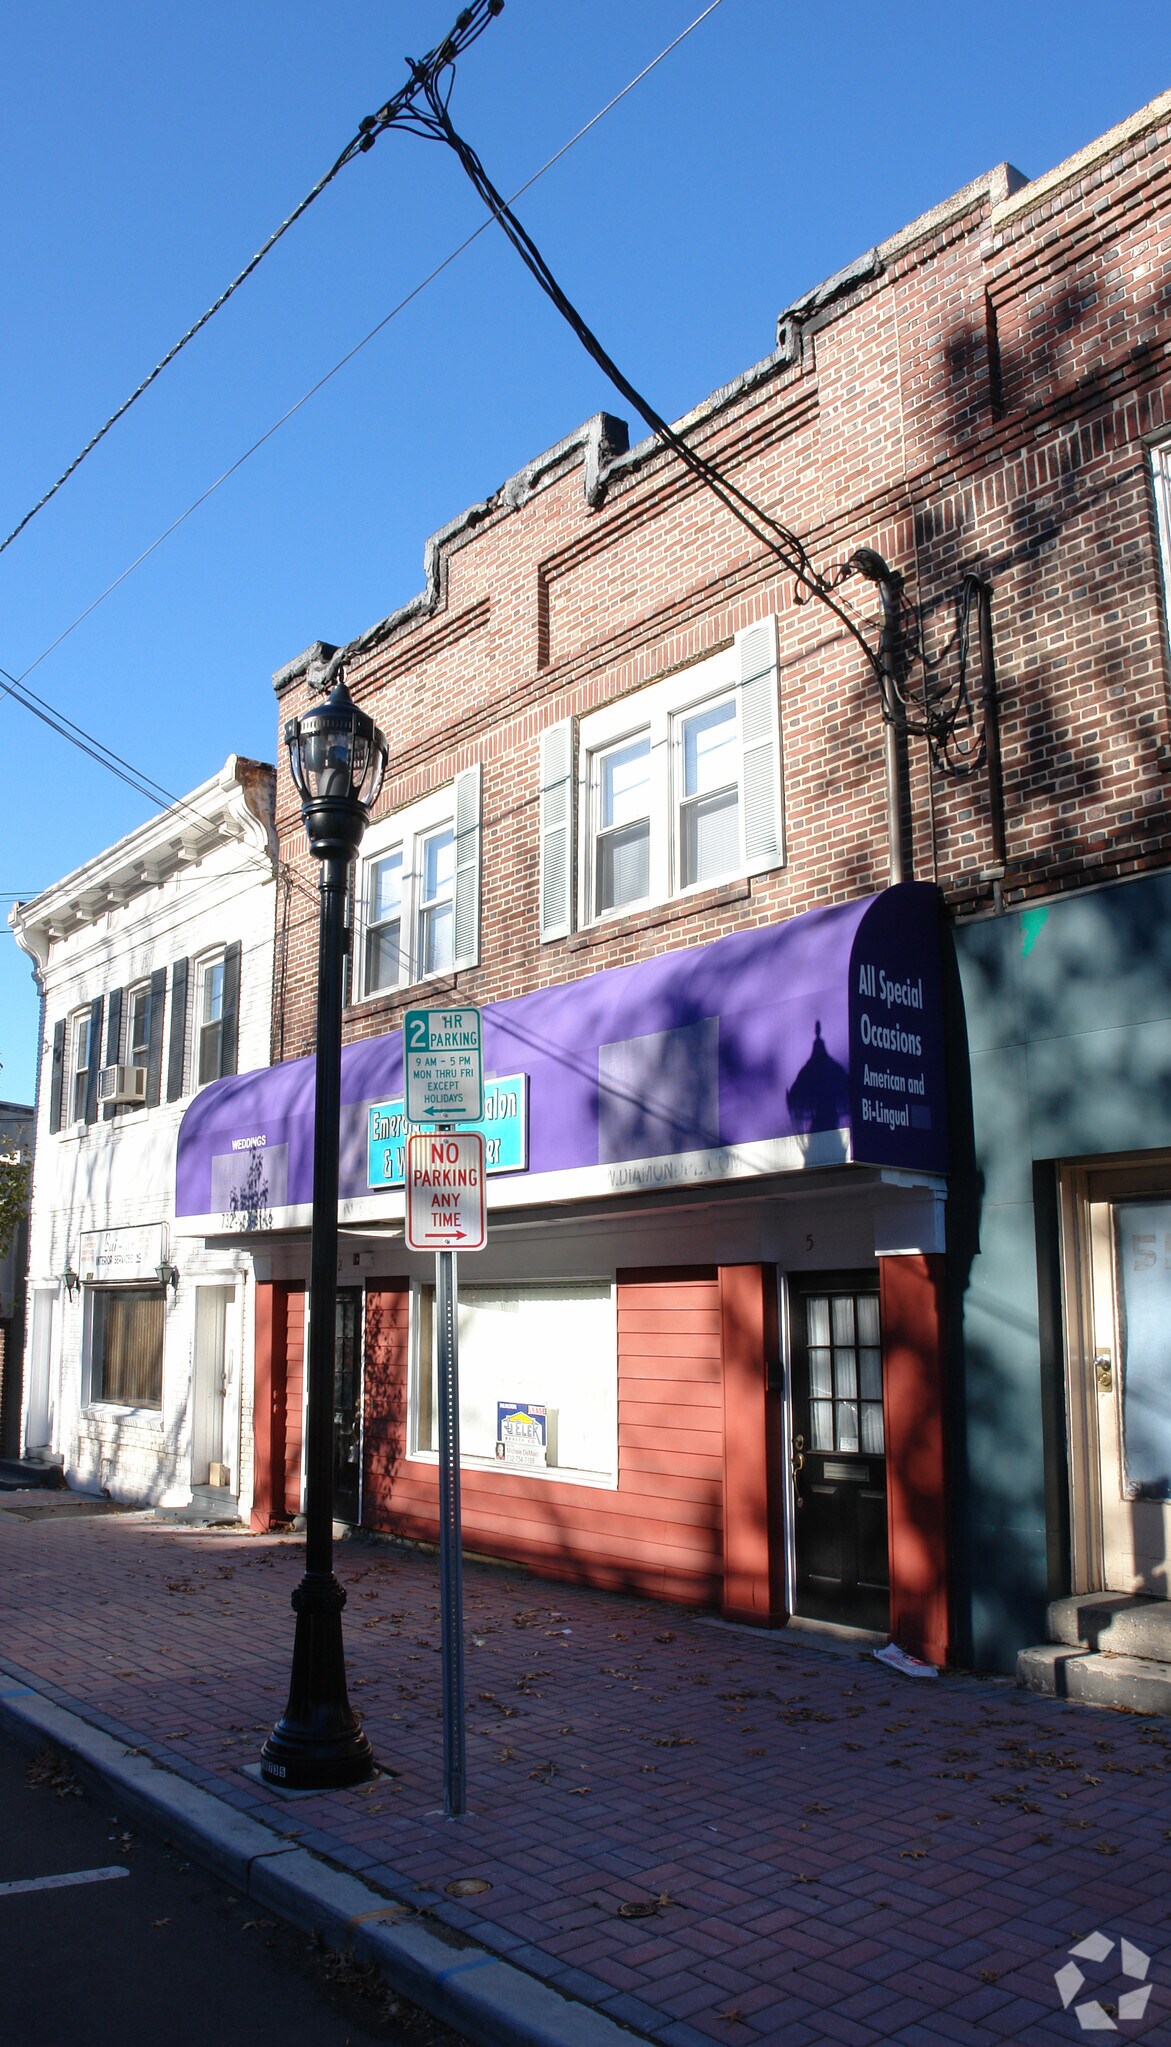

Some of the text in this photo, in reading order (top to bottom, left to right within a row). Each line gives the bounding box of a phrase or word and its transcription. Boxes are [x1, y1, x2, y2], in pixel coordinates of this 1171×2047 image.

[859, 964, 923, 1009] All Special
[410, 1014, 462, 1048] 2 HR
[430, 1031, 477, 1047] PARKING
[861, 1013, 922, 1056] Occasions
[415, 1057, 421, 1067] 9
[425, 1057, 437, 1066] AM
[450, 1056, 456, 1066] 5
[459, 1056, 471, 1066] PM
[413, 1068, 474, 1080] MON THRU FRI
[863, 1063, 925, 1095] American and
[427, 1081, 460, 1091] EXCEPT
[424, 1093, 464, 1104] HOLIDAYS
[862, 1097, 909, 1130] Bi-Lingual
[231, 1134, 267, 1151] WEDDINGS
[431, 1142, 459, 1164] NO
[413, 1168, 478, 1187] PARKING
[431, 1192, 461, 1208] ANY
[431, 1212, 462, 1227] TIME
[806, 1234, 814, 1251] 5
